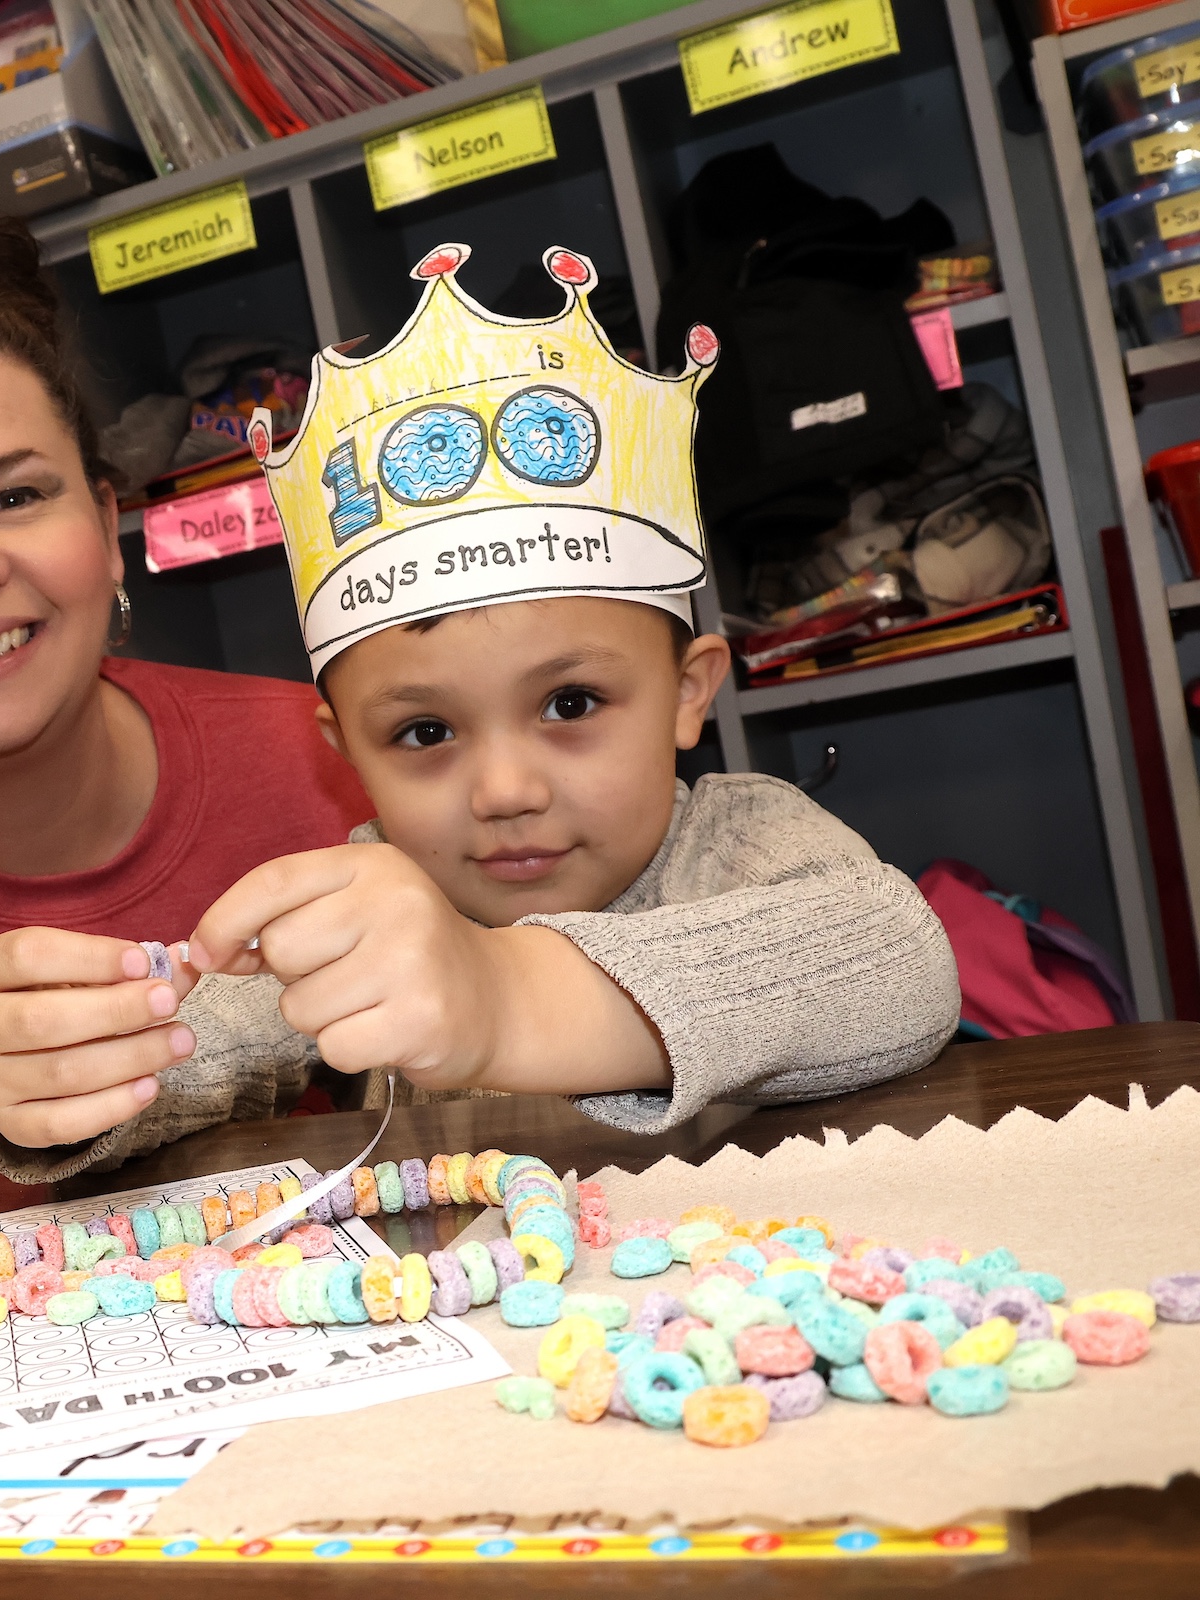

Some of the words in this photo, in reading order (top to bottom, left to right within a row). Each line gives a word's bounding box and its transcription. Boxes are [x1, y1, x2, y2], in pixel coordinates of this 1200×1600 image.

[727, 16, 850, 75] Andrew
[414, 127, 503, 173] Nelson
[114, 210, 234, 269] Jeremiah
[537, 344, 564, 371] is
[322, 384, 601, 547] 100
[340, 559, 418, 612] days
[435, 522, 611, 577] smarter!
[325, 1334, 421, 1368] MY
[123, 1363, 297, 1406] 100TH
